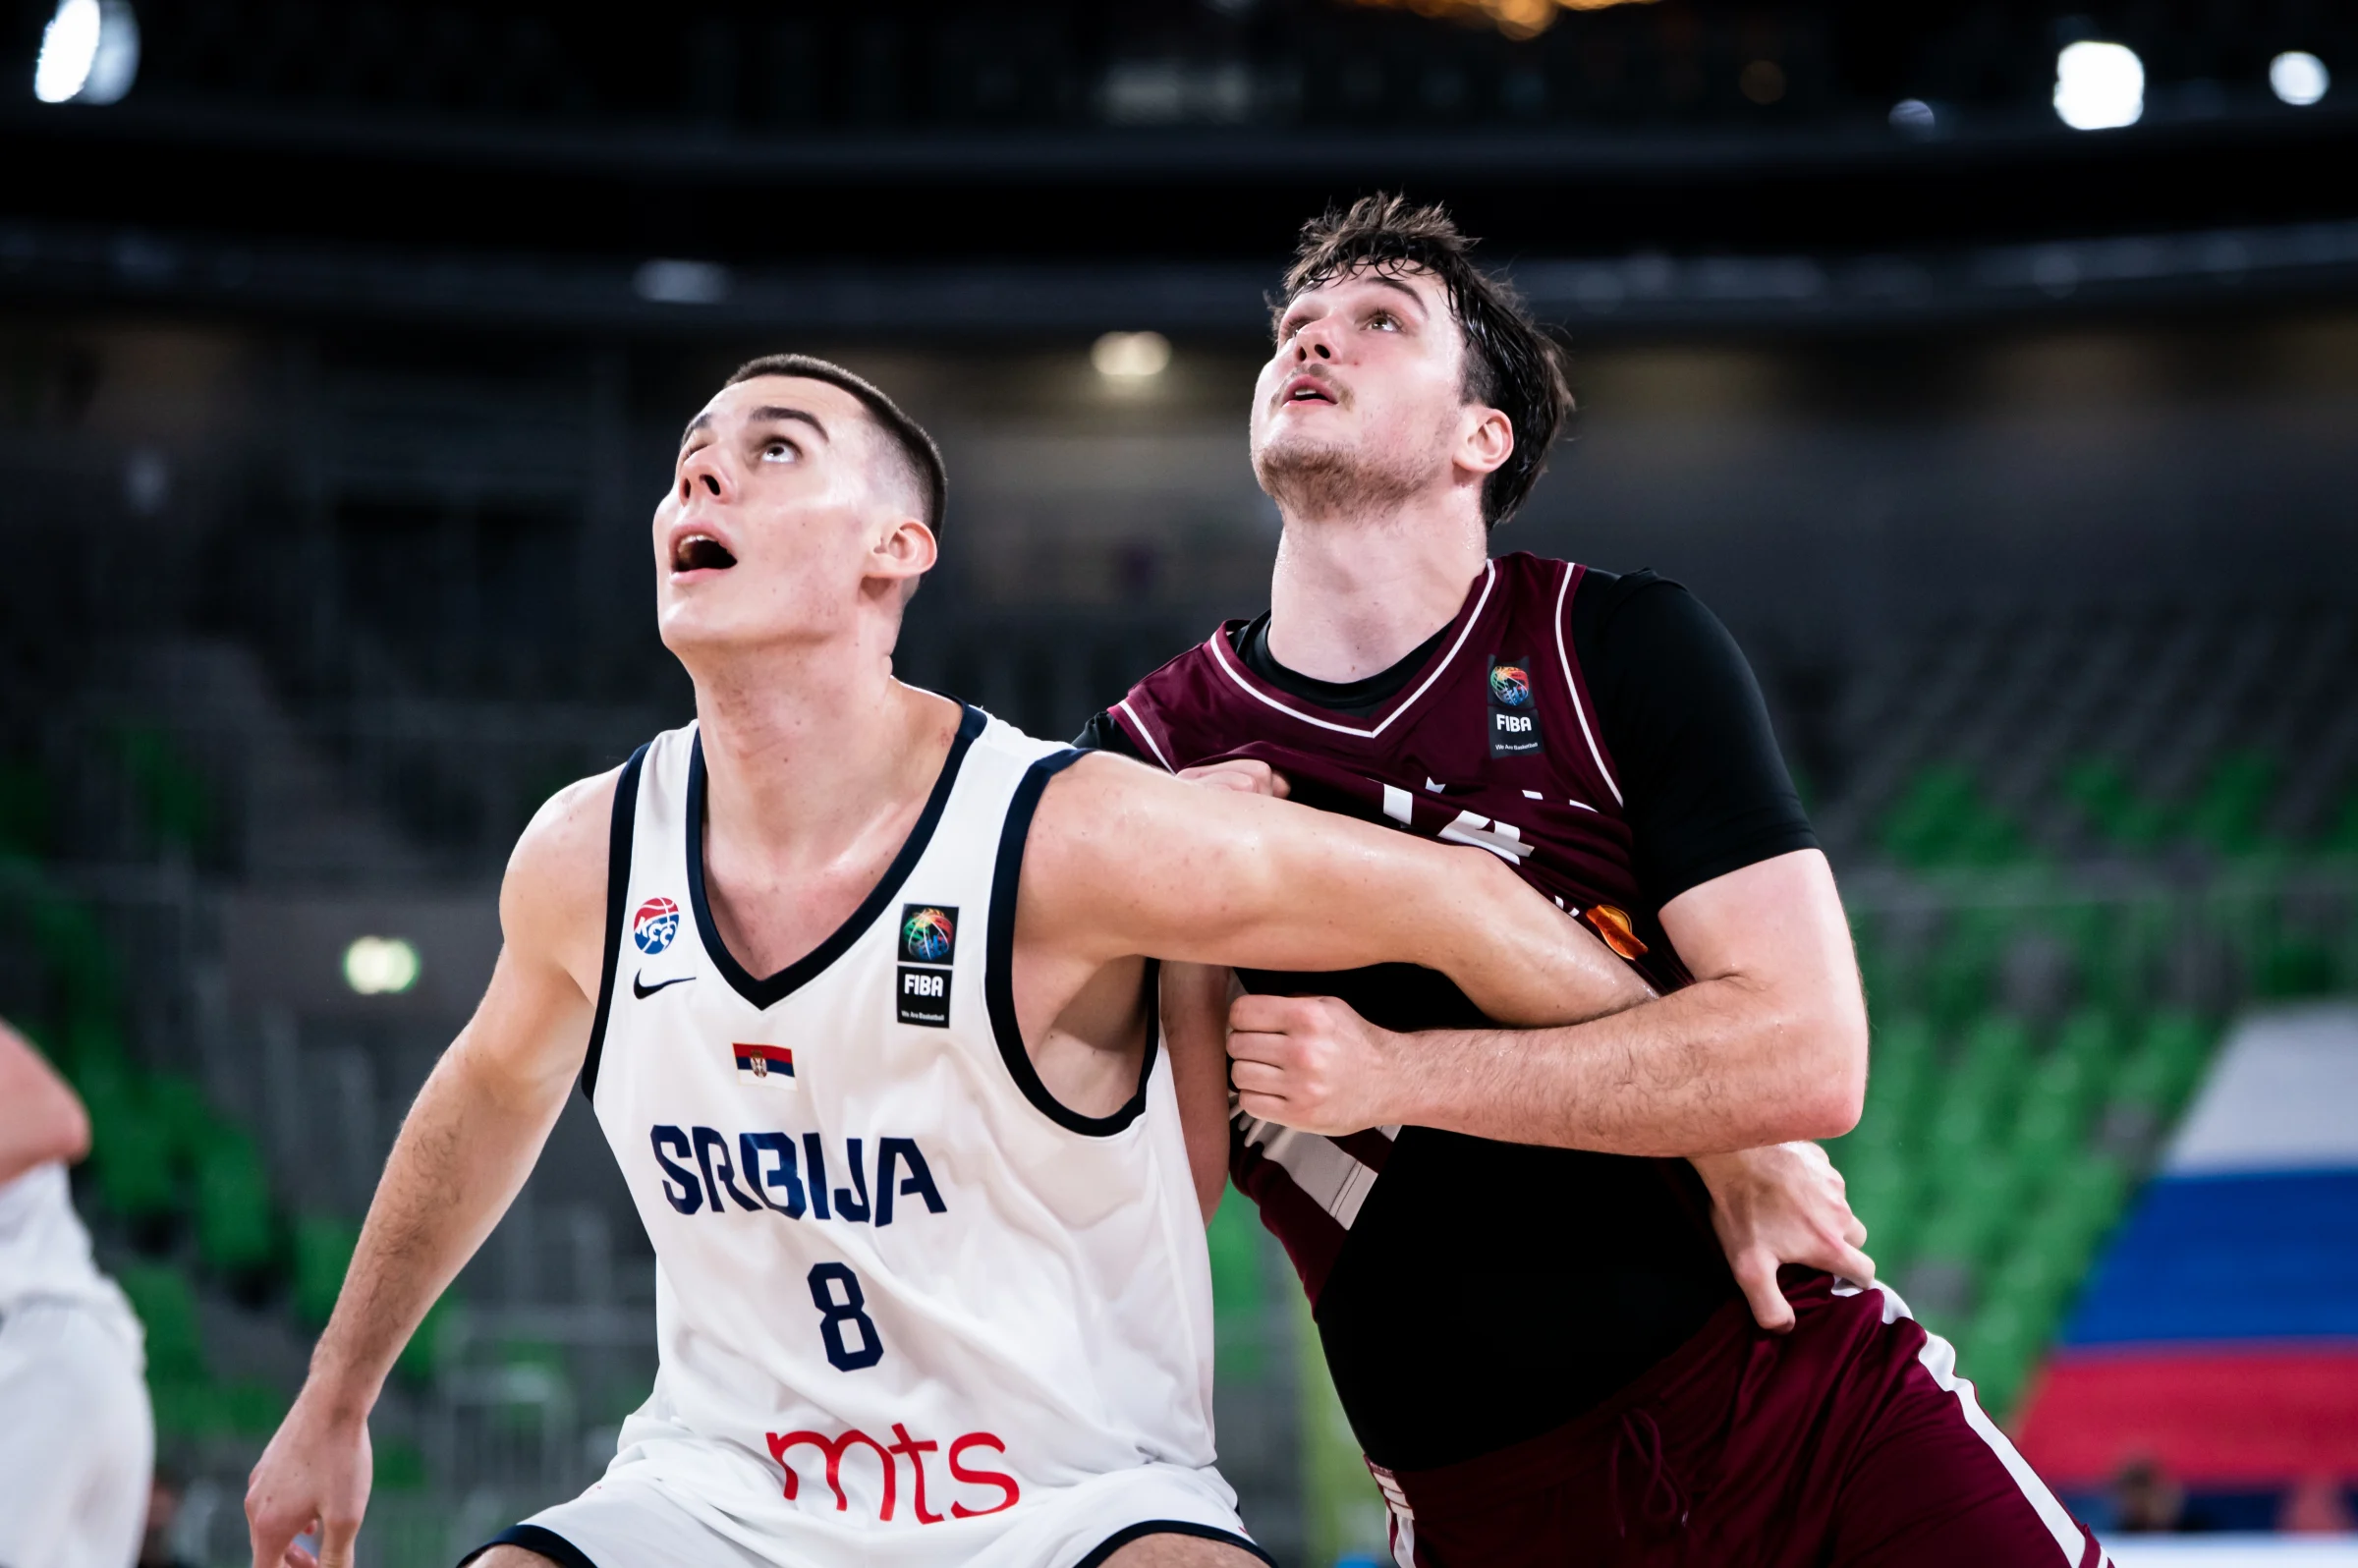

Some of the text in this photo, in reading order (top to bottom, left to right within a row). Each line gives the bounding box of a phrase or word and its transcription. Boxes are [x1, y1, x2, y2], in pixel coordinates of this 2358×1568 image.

[1496, 713, 1532, 733] FIBA
[904, 973, 944, 997] FIBA
[649, 1124, 948, 1228] SRBIJA
[807, 1261, 884, 1372] 8
[764, 1422, 1021, 1525] mts
